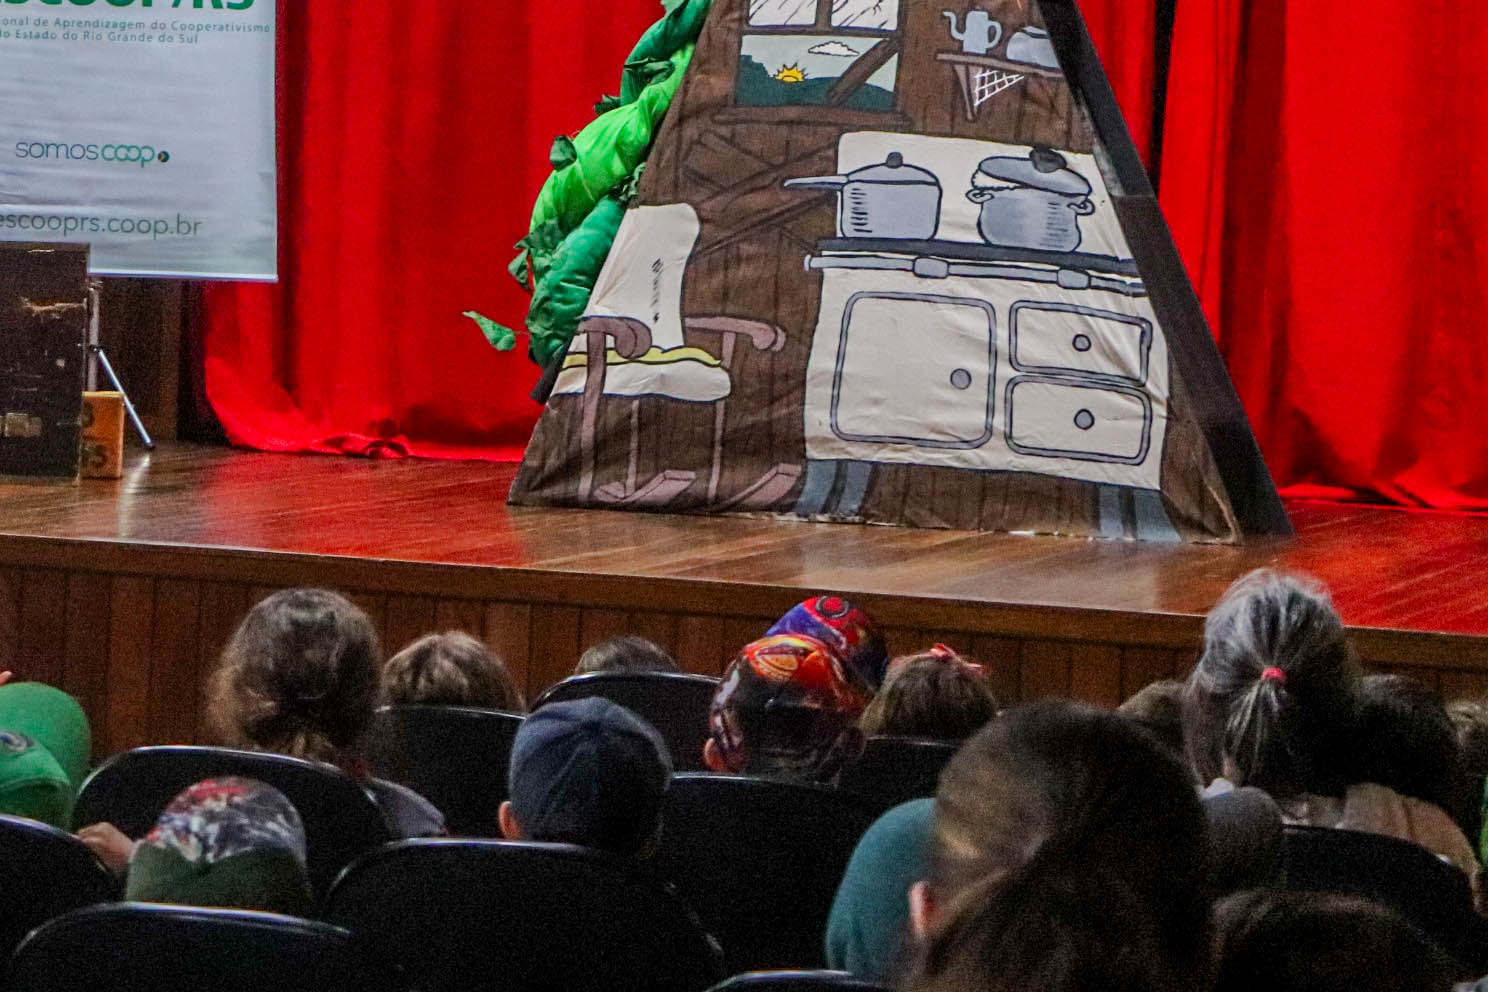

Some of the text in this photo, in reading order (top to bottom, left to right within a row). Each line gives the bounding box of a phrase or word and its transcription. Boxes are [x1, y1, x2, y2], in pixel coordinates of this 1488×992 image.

[34, 17, 48, 27] de
[54, 17, 145, 31] Aprendizagem
[151, 20, 167, 31] do
[171, 21, 270, 33] Cooperativismo
[15, 31, 57, 40] Estado
[63, 31, 78, 40] do
[83, 31, 102, 40] Rio
[108, 32, 153, 42] Grande
[158, 33, 174, 43] do
[179, 34, 198, 44] Sul
